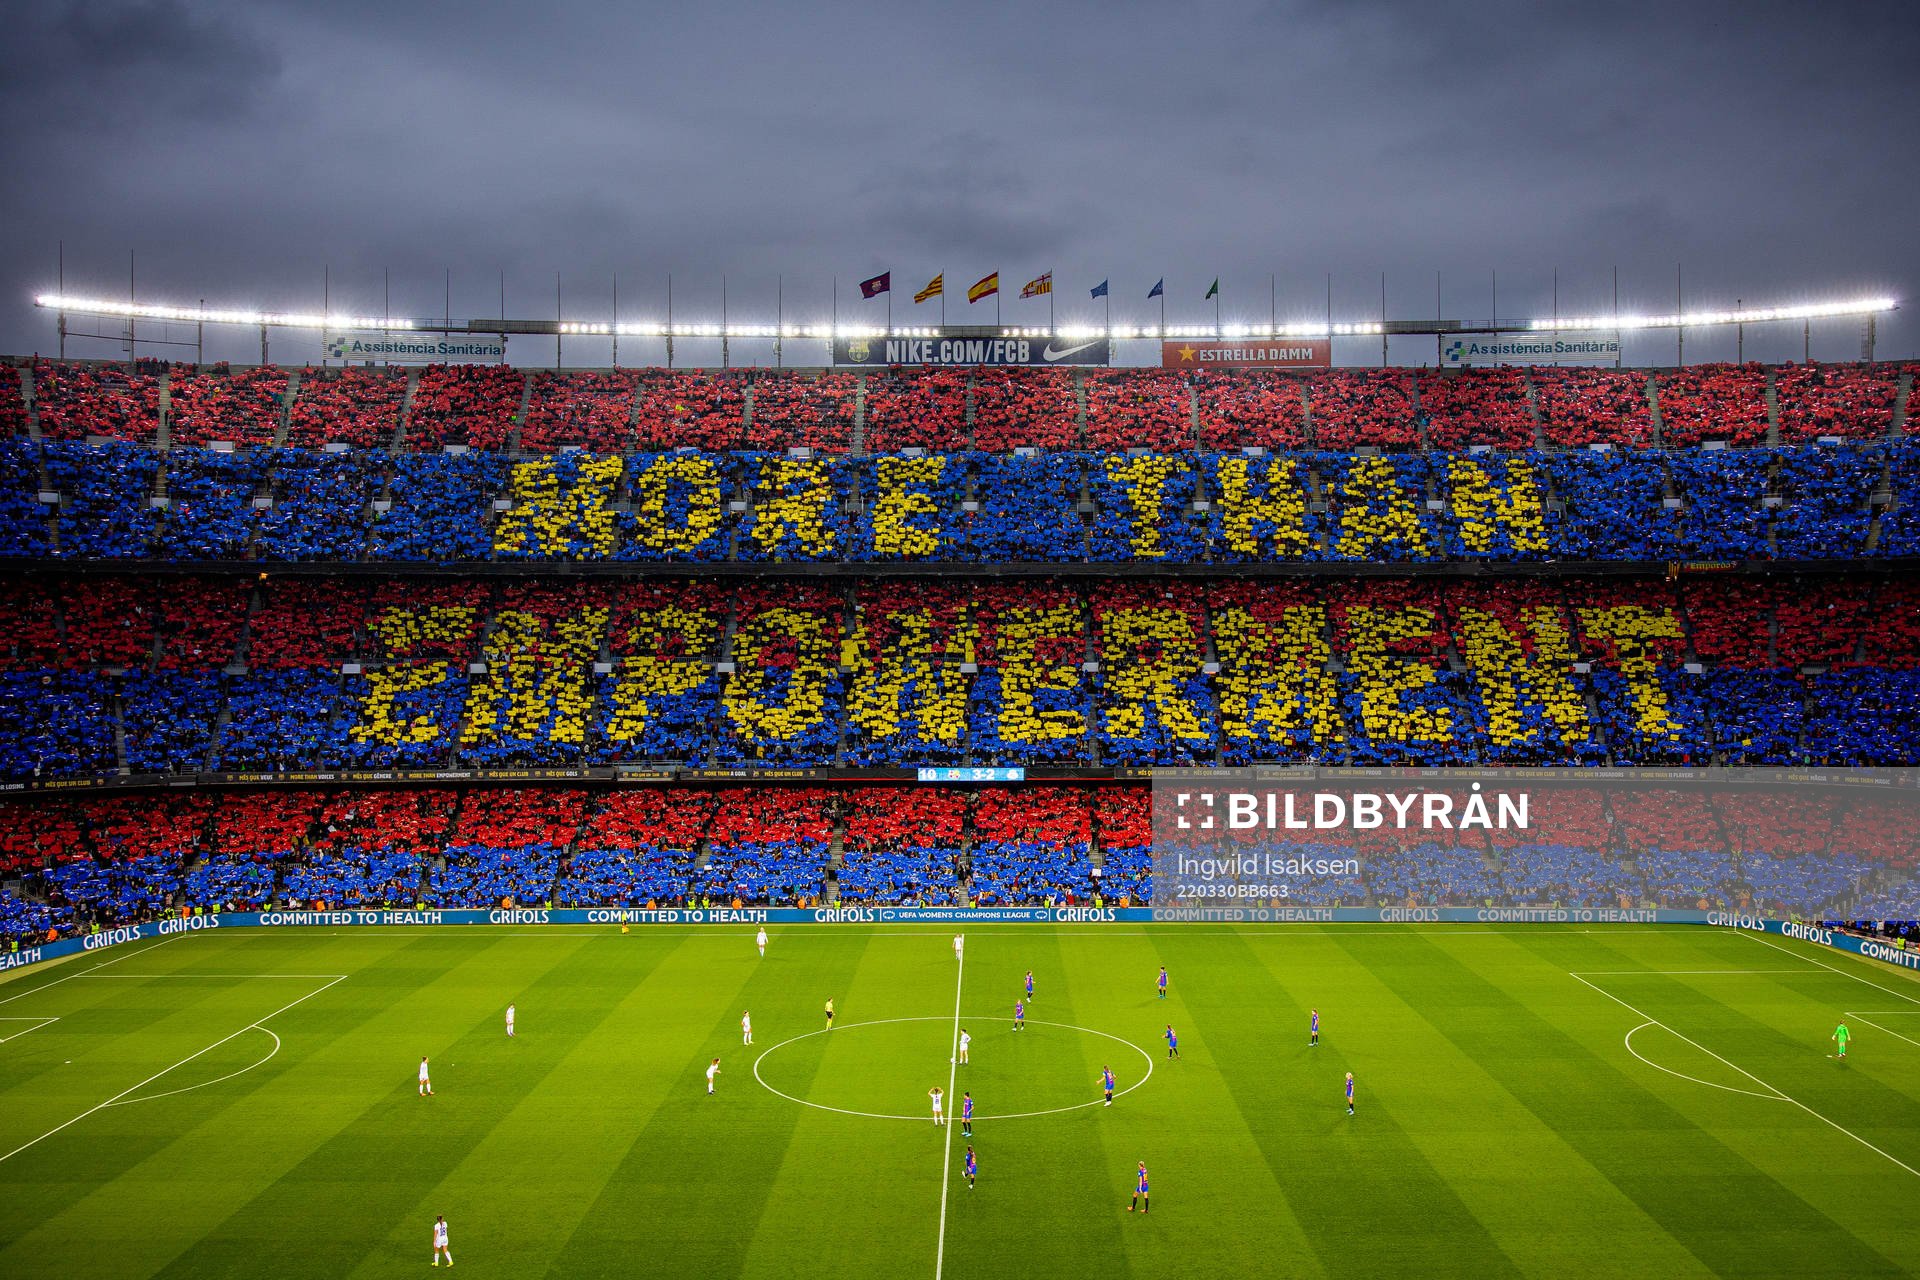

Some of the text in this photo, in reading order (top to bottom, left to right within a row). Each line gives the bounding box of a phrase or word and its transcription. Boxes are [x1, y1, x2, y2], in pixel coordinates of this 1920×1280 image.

[352, 340, 501, 355] Assistència Sanitària
[886, 340, 1030, 363] NIKE.COM/FCB
[1470, 341, 1619, 355] Assistència Sanitària
[1199, 348, 1313, 362] ESTRELLA DAMM
[972, 769, 994, 780] 3-2
[260, 913, 442, 926] COMMITTED TO HEALTH
[489, 910, 548, 924] GRIFOLS
[587, 910, 767, 923] COMMITTED TO HEALTH
[814, 909, 874, 922] GRIFOLS
[1056, 908, 1116, 922] GRIFOLS
[1153, 909, 1333, 922] COMMITTED TO HEALTH
[1380, 908, 1439, 922] GRIFOLS
[1477, 909, 1657, 922] COMMITTED TO HEALTH
[1706, 911, 1765, 931] GRIFOLS
[158, 914, 219, 935] GRIFOLS
[83, 926, 141, 950] GRIFOLS
[1781, 921, 1833, 946] GRIFOLS
